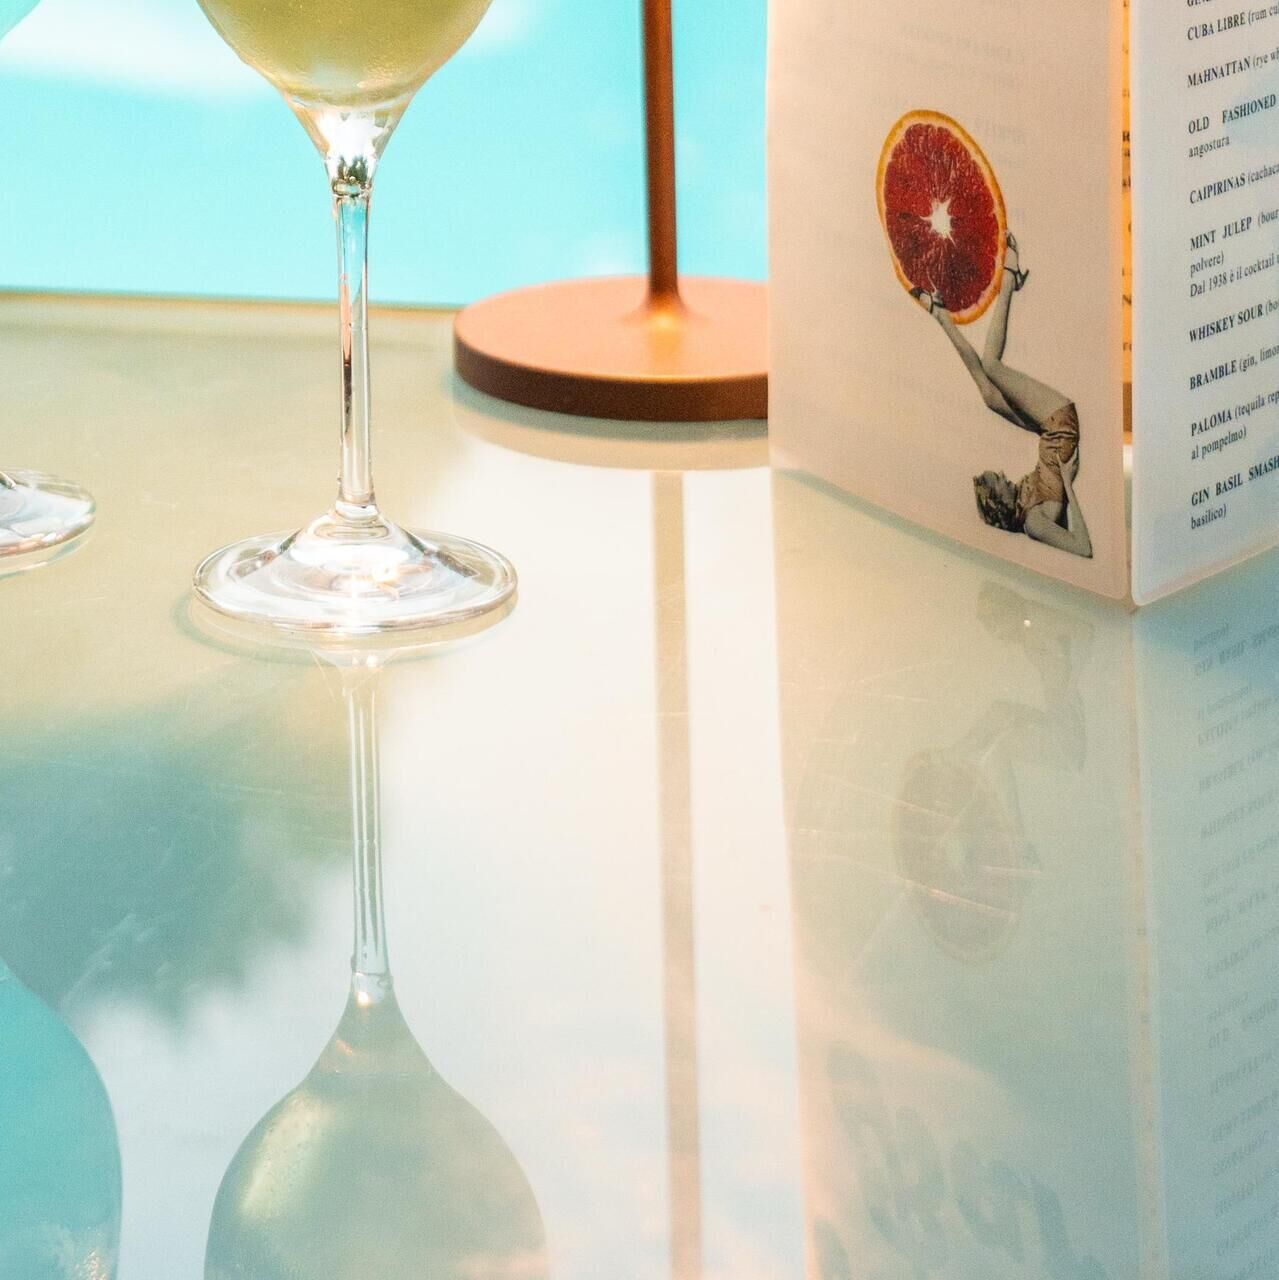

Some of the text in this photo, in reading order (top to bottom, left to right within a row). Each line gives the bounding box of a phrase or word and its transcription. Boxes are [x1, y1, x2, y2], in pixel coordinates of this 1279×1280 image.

[1187, 24, 1214, 41] CUBA
[1217, 12, 1246, 33] LIBRE
[1248, 8, 1267, 25] (rum
[1187, 56, 1251, 87] MAHNATTAN
[1253, 54, 1268, 69] (rye
[1188, 94, 1276, 134] OLD FASHIONED
[1188, 136, 1230, 158] angostura
[1190, 172, 1246, 204] CAIPIRINAS
[1190, 229, 1216, 251] MINT
[1222, 216, 1252, 239] JULEP
[1190, 250, 1224, 278] polvere)
[1190, 280, 1205, 297] Dal
[1209, 272, 1227, 291] 1938
[1230, 269, 1234, 283] è
[1236, 266, 1242, 280] il
[1244, 253, 1275, 277] cocktail
[1189, 299, 1279, 342] WHISKEY SOUR (bo
[1190, 360, 1237, 390] BRAMBLE
[1239, 354, 1258, 372] (gin,
[1191, 408, 1233, 437] PALOMA
[1234, 394, 1265, 419] (tequila
[1191, 425, 1247, 460] al pompelmo)
[1191, 486, 1210, 506] GIN
[1216, 473, 1243, 496] BASIL
[1191, 503, 1227, 530] basilico)
